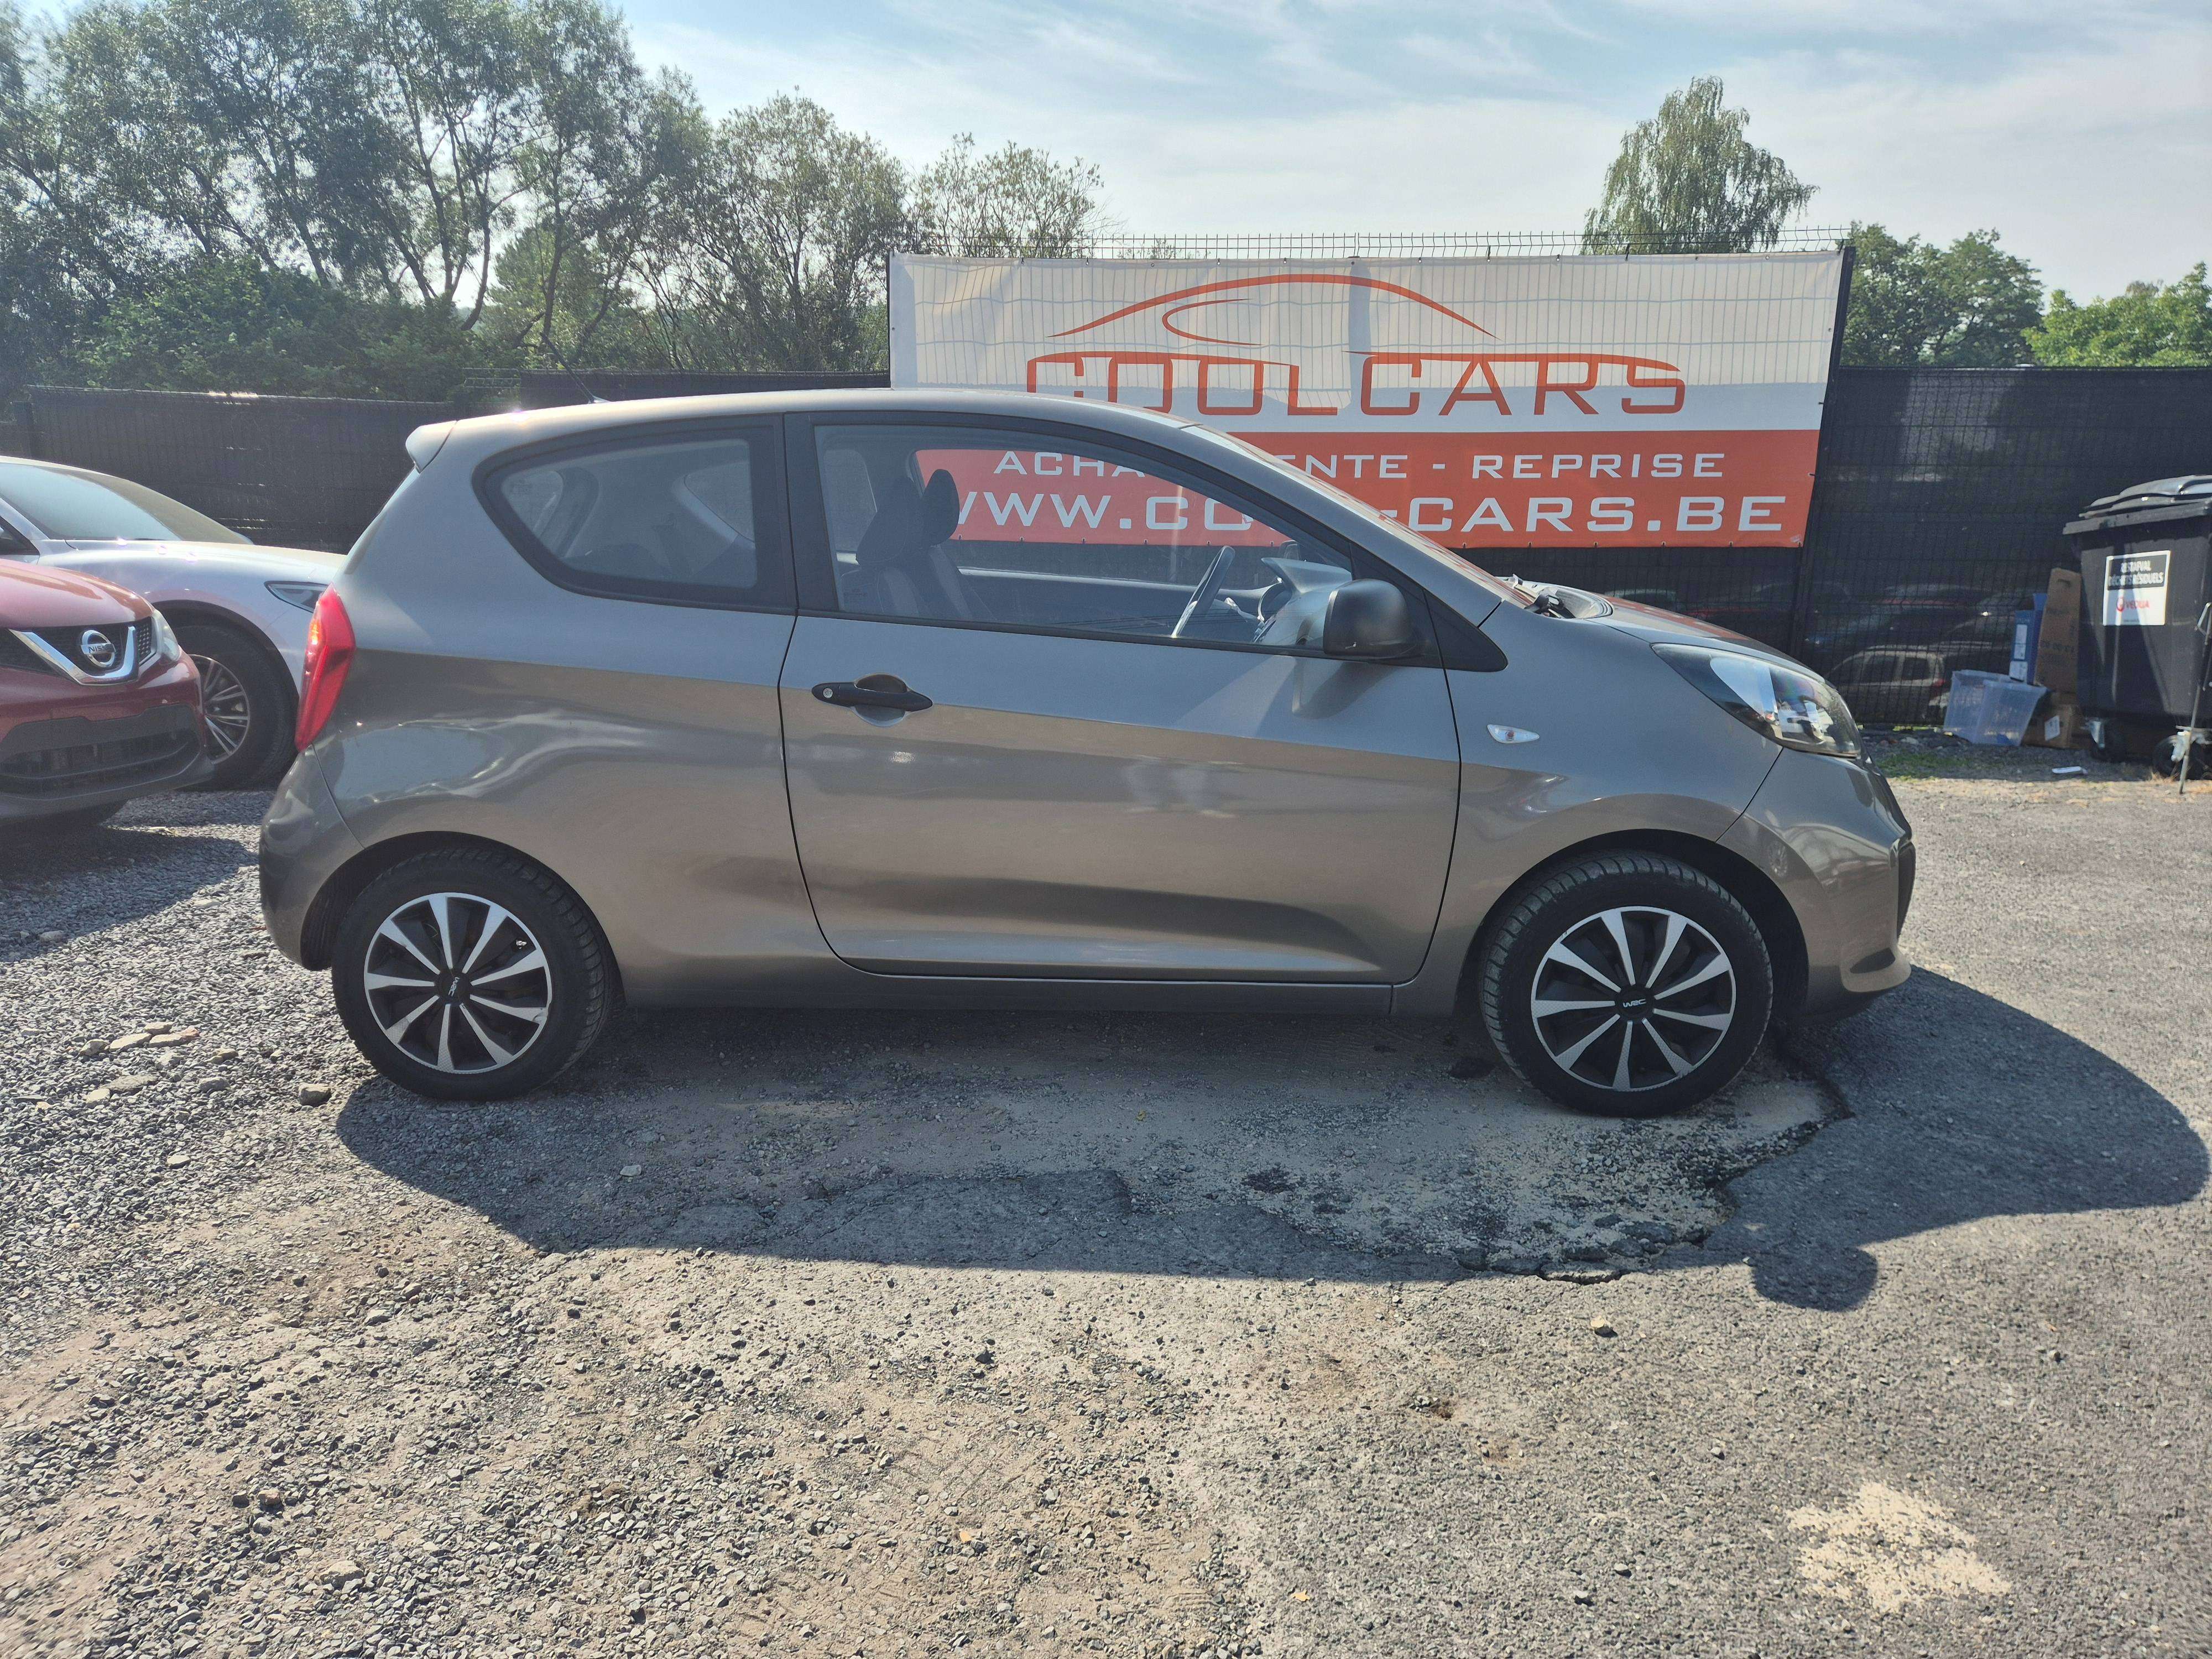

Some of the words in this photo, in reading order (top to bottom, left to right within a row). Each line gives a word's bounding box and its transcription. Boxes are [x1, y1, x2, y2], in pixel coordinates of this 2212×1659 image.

[1345, 351, 1686, 415] CARS
[993, 451, 1145, 477] ACHA
[1472, 453, 1725, 478] REPRISE
